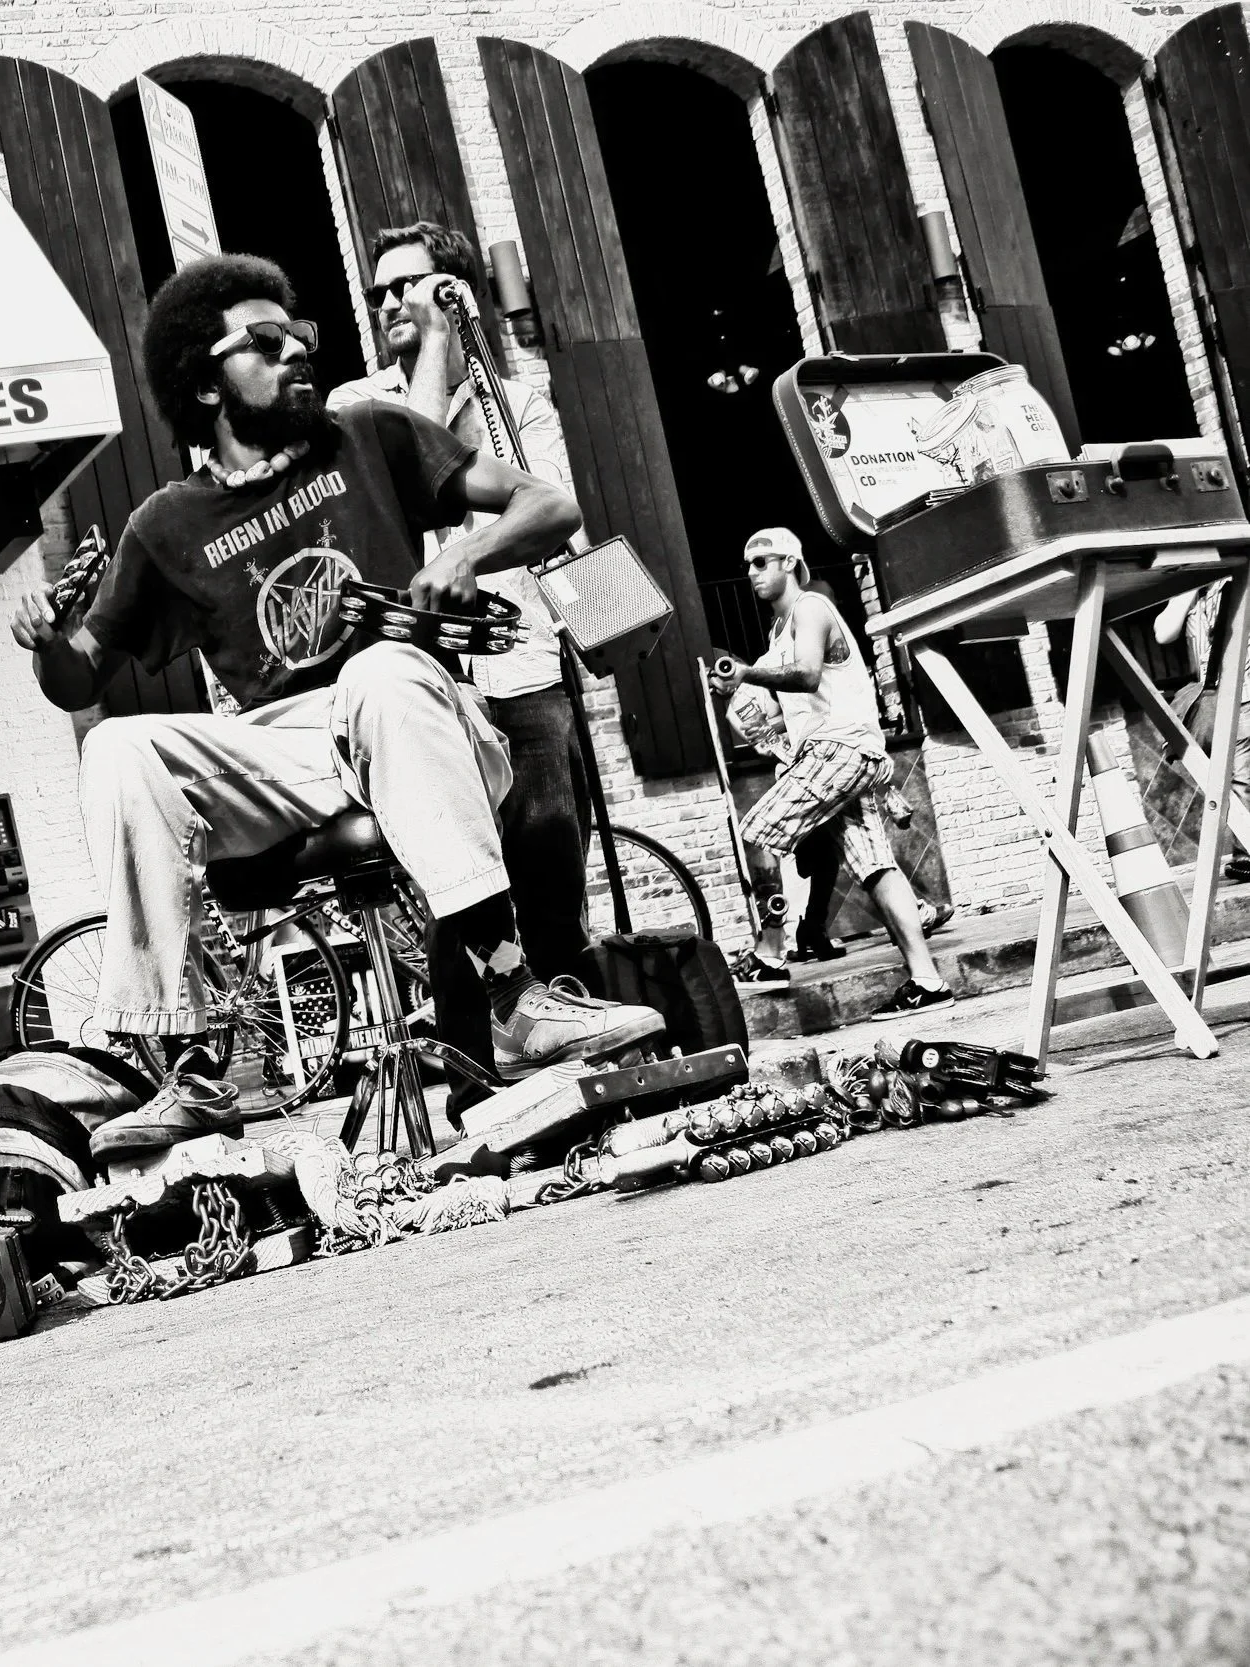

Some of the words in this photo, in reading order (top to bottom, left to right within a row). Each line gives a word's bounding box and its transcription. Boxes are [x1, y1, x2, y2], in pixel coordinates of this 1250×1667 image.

[850, 451, 916, 466] DONATION
[860, 475, 877, 487] CD
[203, 517, 266, 569] REIGN
[262, 502, 291, 535] IN
[287, 470, 347, 520] BLOOD
